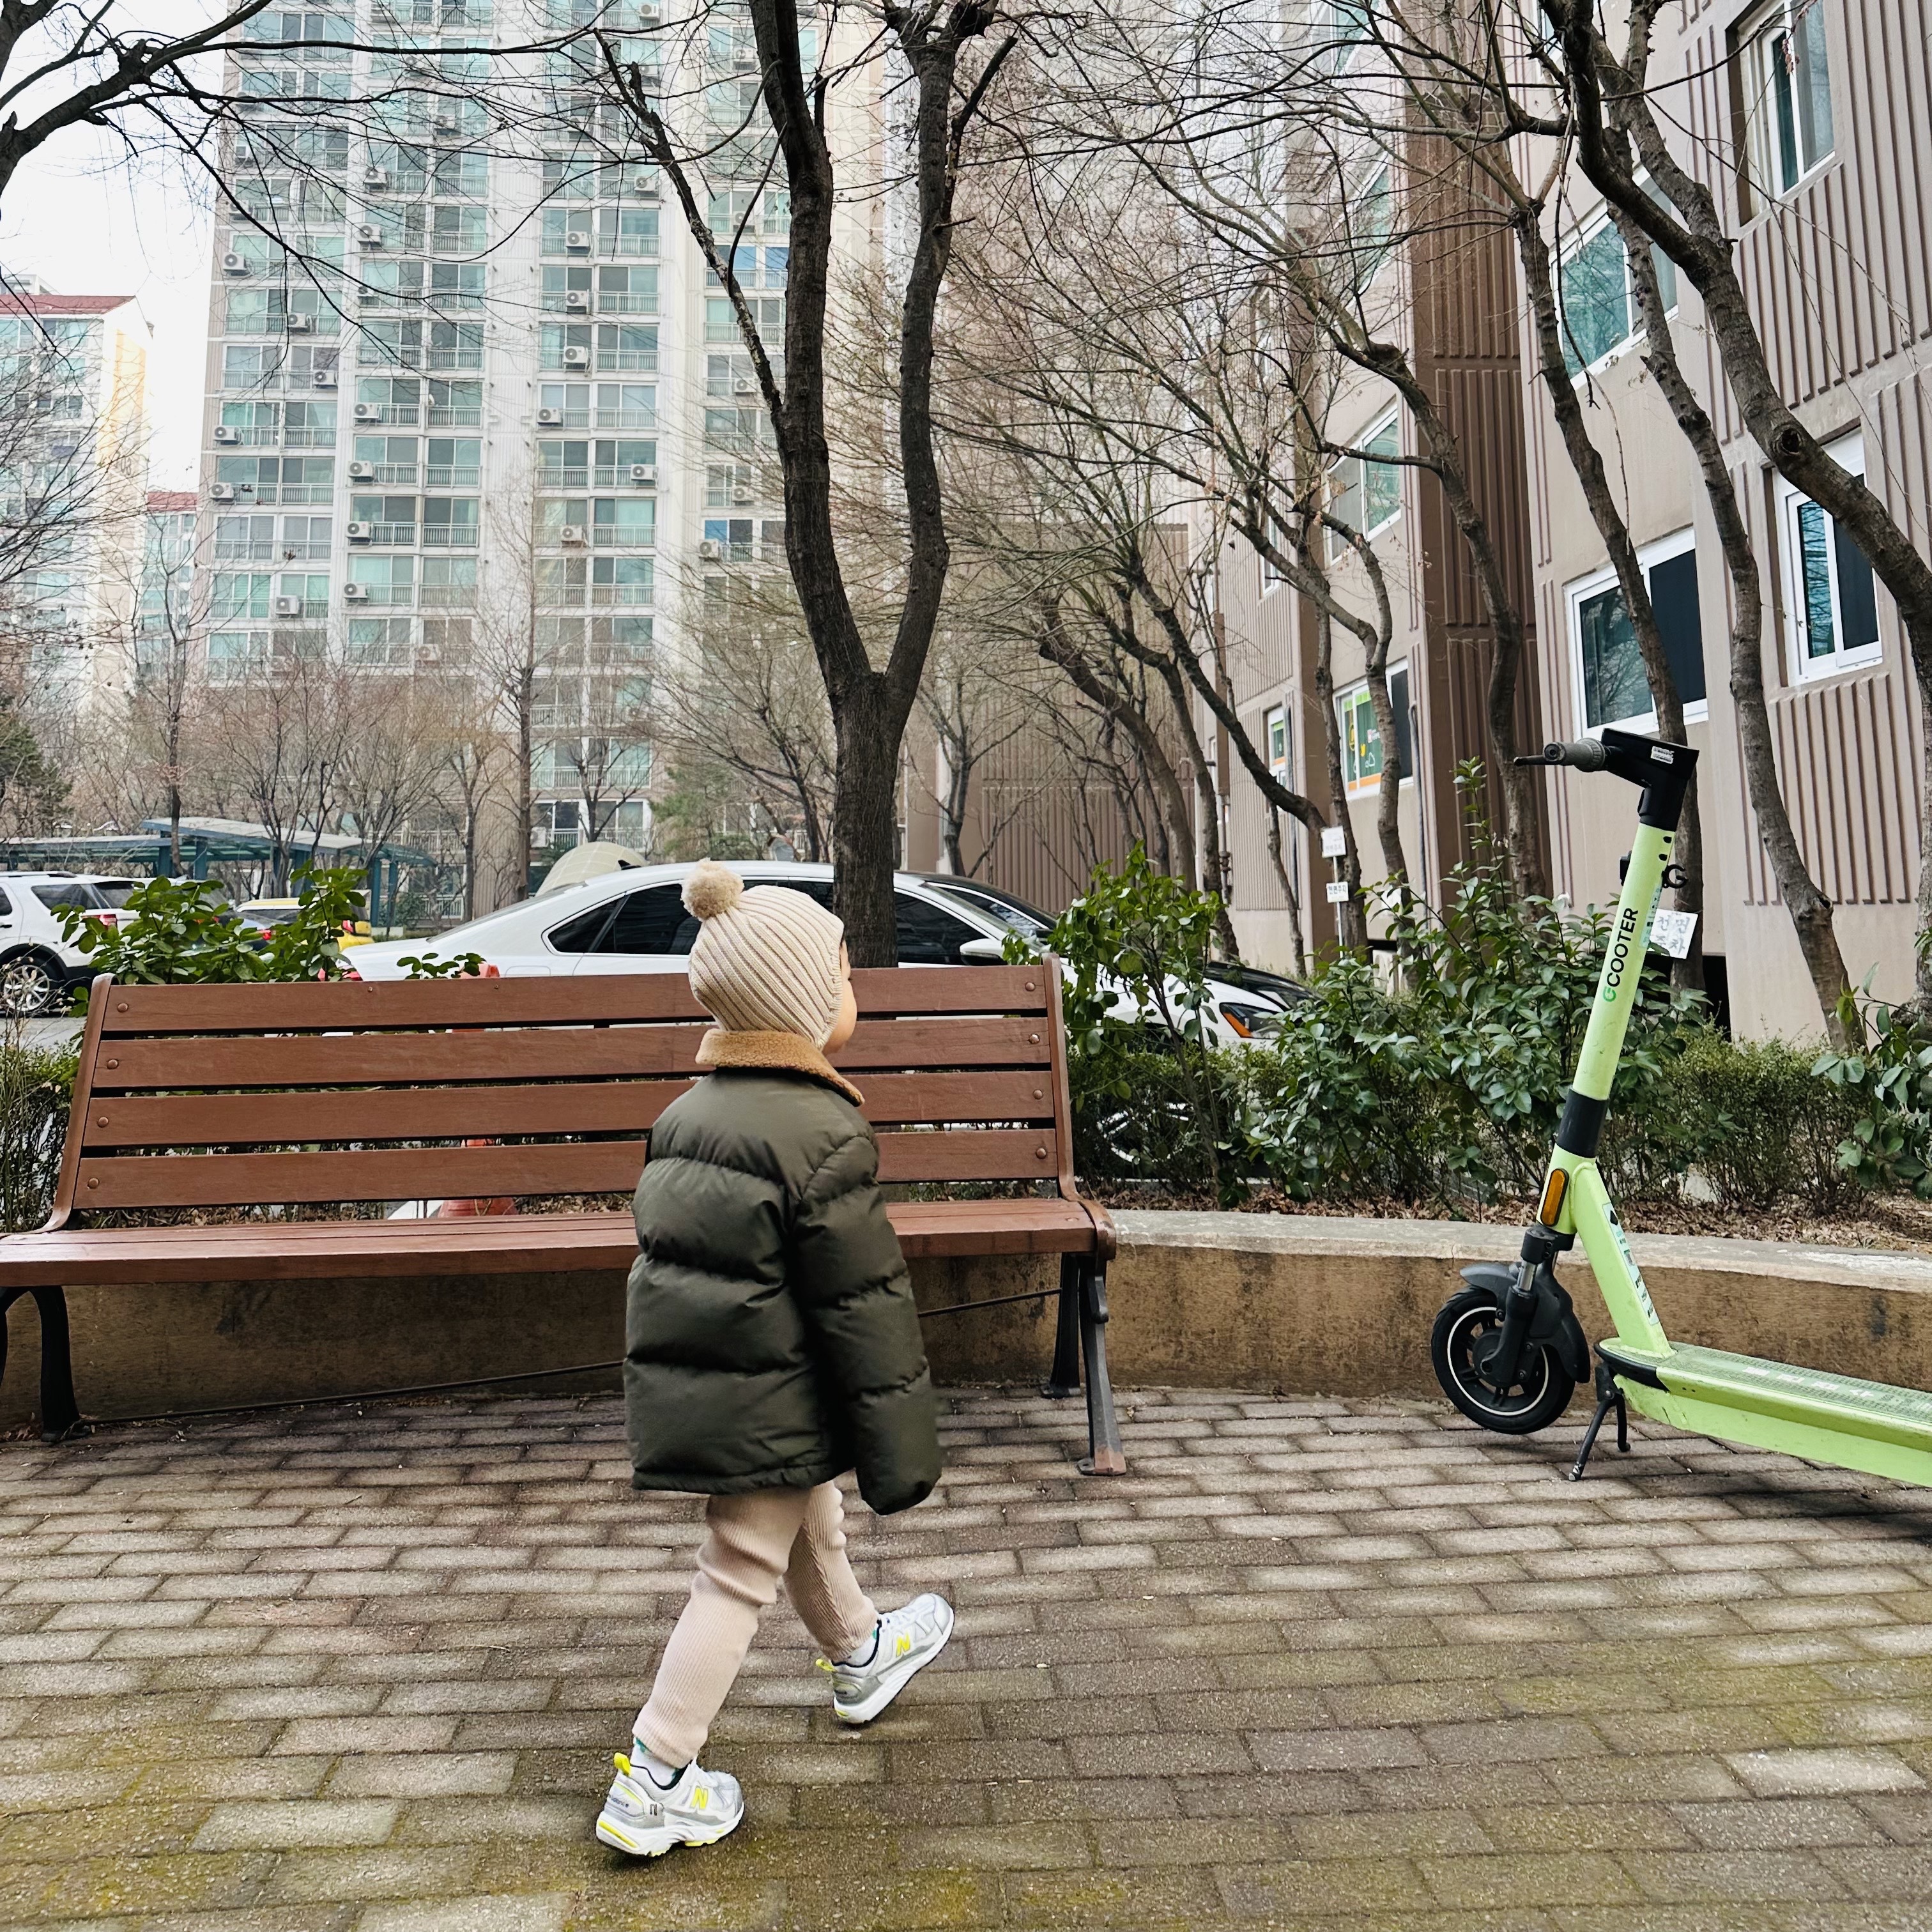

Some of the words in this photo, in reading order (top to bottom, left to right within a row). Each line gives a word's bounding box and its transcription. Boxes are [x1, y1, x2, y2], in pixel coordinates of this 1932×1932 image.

[1656, 915, 1690, 933] 전면
[1603, 908, 1638, 1002] GCOOTER
[1656, 936, 1685, 955] 주차
[896, 1631, 910, 1658] N
[691, 1787, 709, 1809] N
